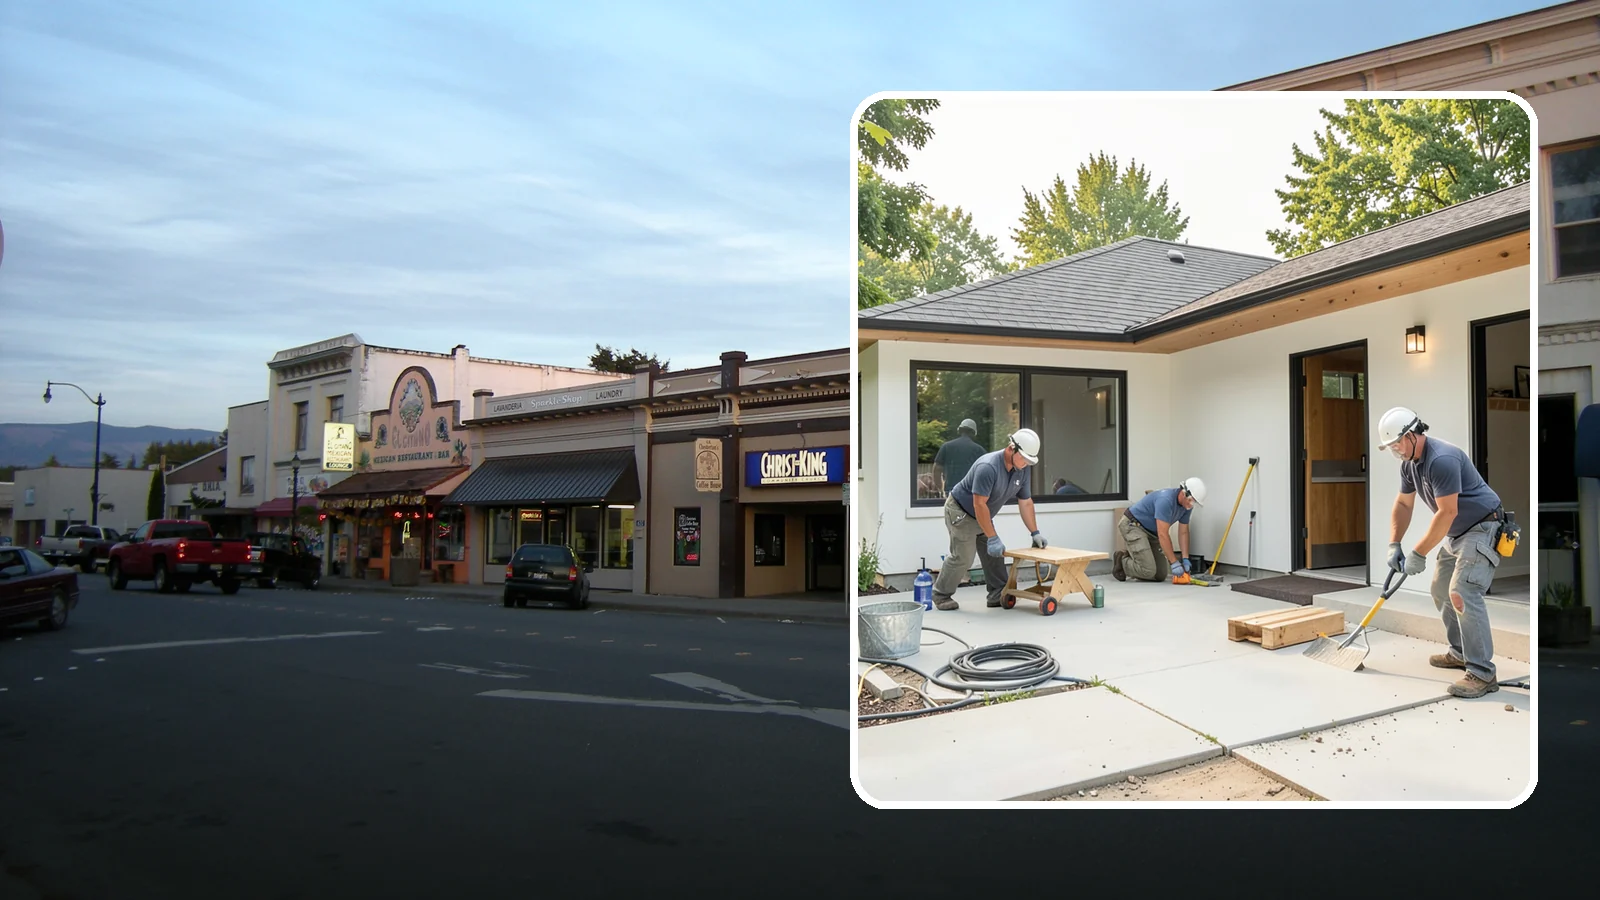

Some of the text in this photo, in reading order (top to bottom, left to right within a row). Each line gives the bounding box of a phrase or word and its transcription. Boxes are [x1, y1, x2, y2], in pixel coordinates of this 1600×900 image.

[562, 394, 582, 404] Shop
[596, 389, 623, 400] LAUNDRY
[493, 402, 522, 412] LAVANDERIA
[397, 452, 433, 462] RESTAURANT
[438, 450, 449, 459] BAR
[761, 450, 827, 477] CHRIST KING
